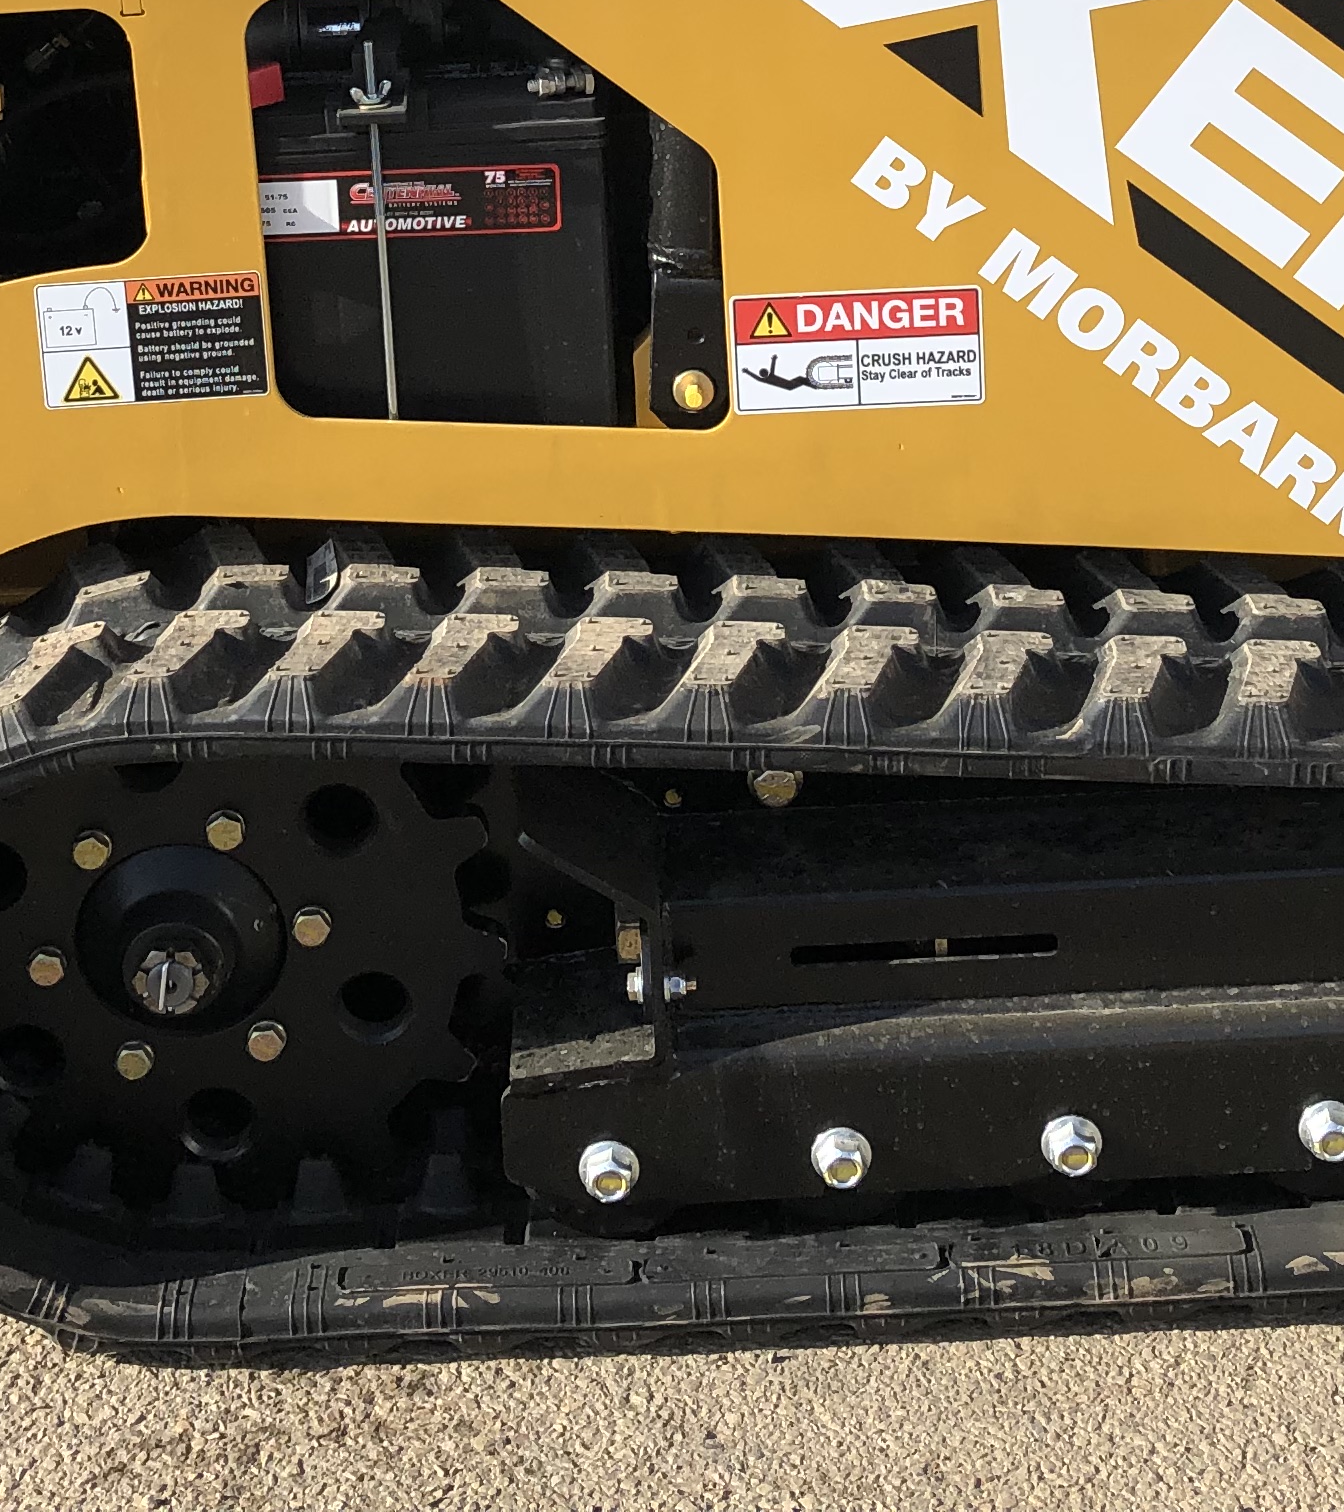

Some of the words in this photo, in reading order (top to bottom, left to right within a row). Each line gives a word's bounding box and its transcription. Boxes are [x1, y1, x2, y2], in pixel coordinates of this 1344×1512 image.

[484, 171, 505, 184] 75
[850, 135, 987, 243] BY
[347, 216, 466, 232] AUOMOTIVE
[156, 277, 255, 298] WARNING
[139, 301, 196, 315] EXPLOSION
[199, 298, 244, 311] HAZARD!
[796, 297, 965, 333] DANGER
[135, 320, 170, 330] Positive
[172, 318, 215, 329] grounding
[217, 316, 241, 325] could
[59, 326, 72, 337] 12
[136, 330, 161, 339] cause
[163, 328, 193, 338] battery
[195, 328, 204, 336] to
[207, 325, 242, 336] explode.
[138, 344, 168, 354] Battery
[171, 342, 199, 351] should
[202, 340, 213, 349] be
[215, 338, 255, 349] grounded
[139, 353, 162, 364] using
[164, 351, 200, 362] negative
[203, 349, 235, 360] ground.
[860, 351, 912, 367] CRUSH
[916, 350, 976, 365] HAZARD
[140, 369, 170, 379] Failure
[172, 369, 181, 377] to
[183, 367, 213, 378] comply
[216, 365, 239, 374] could
[861, 369, 885, 383] Stay
[889, 368, 918, 380] Clear
[921, 367, 933, 378] of
[935, 366, 972, 377] Tracks
[141, 378, 166, 388] result
[168, 378, 176, 386] in
[178, 376, 222, 387] equipment
[142, 388, 165, 397] death
[179, 385, 211, 395] serious
[213, 383, 239, 394] injury.
